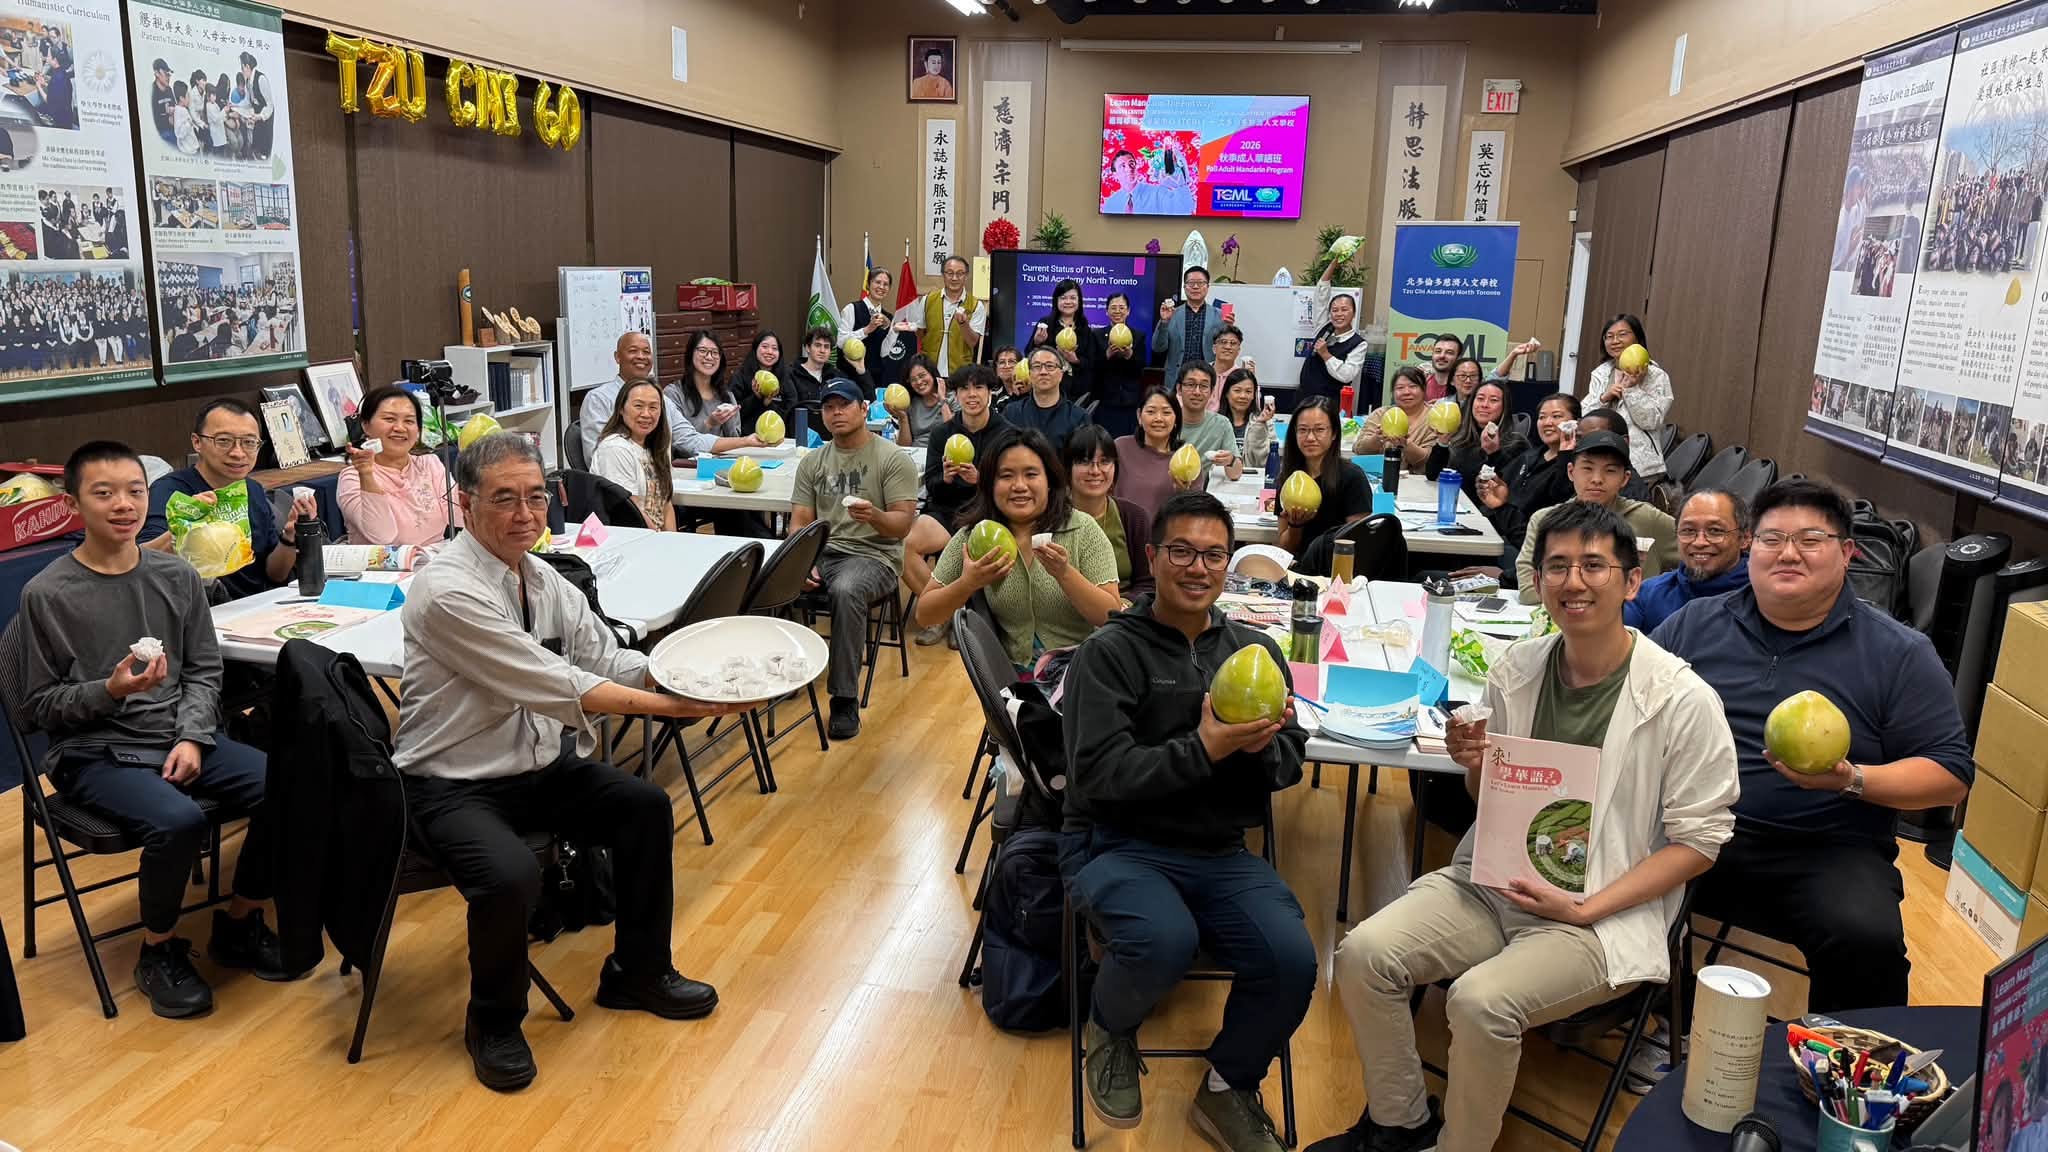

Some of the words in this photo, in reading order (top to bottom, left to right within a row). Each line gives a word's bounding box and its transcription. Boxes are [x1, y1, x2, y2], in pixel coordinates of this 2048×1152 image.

[66, 4, 110, 22] Curriculum
[326, 30, 427, 124] TZU
[533, 80, 582, 151] 60
[1110, 98, 1130, 107] Learn
[1487, 91, 1515, 112] EXIT
[1240, 140, 1262, 150] 2026
[992, 96, 1015, 215] 慈濟宗門
[1397, 101, 1429, 221] 靜思法脈
[1206, 165, 1218, 173] Fall
[1236, 166, 1266, 174] Mandarin
[1266, 167, 1294, 176] Program
[932, 129, 949, 266] 永誌法脈宗門弘願
[1022, 263, 1049, 272] Current
[1050, 264, 1075, 274] Status
[1075, 265, 1084, 274] of
[1085, 266, 1107, 275] TCML
[1022, 274, 1036, 282] Tzu
[1037, 274, 1050, 282] Chi
[1086, 276, 1107, 285] North
[1108, 277, 1138, 286] Toronto
[1406, 277, 1499, 288] 北多倫多慈濟人文學校
